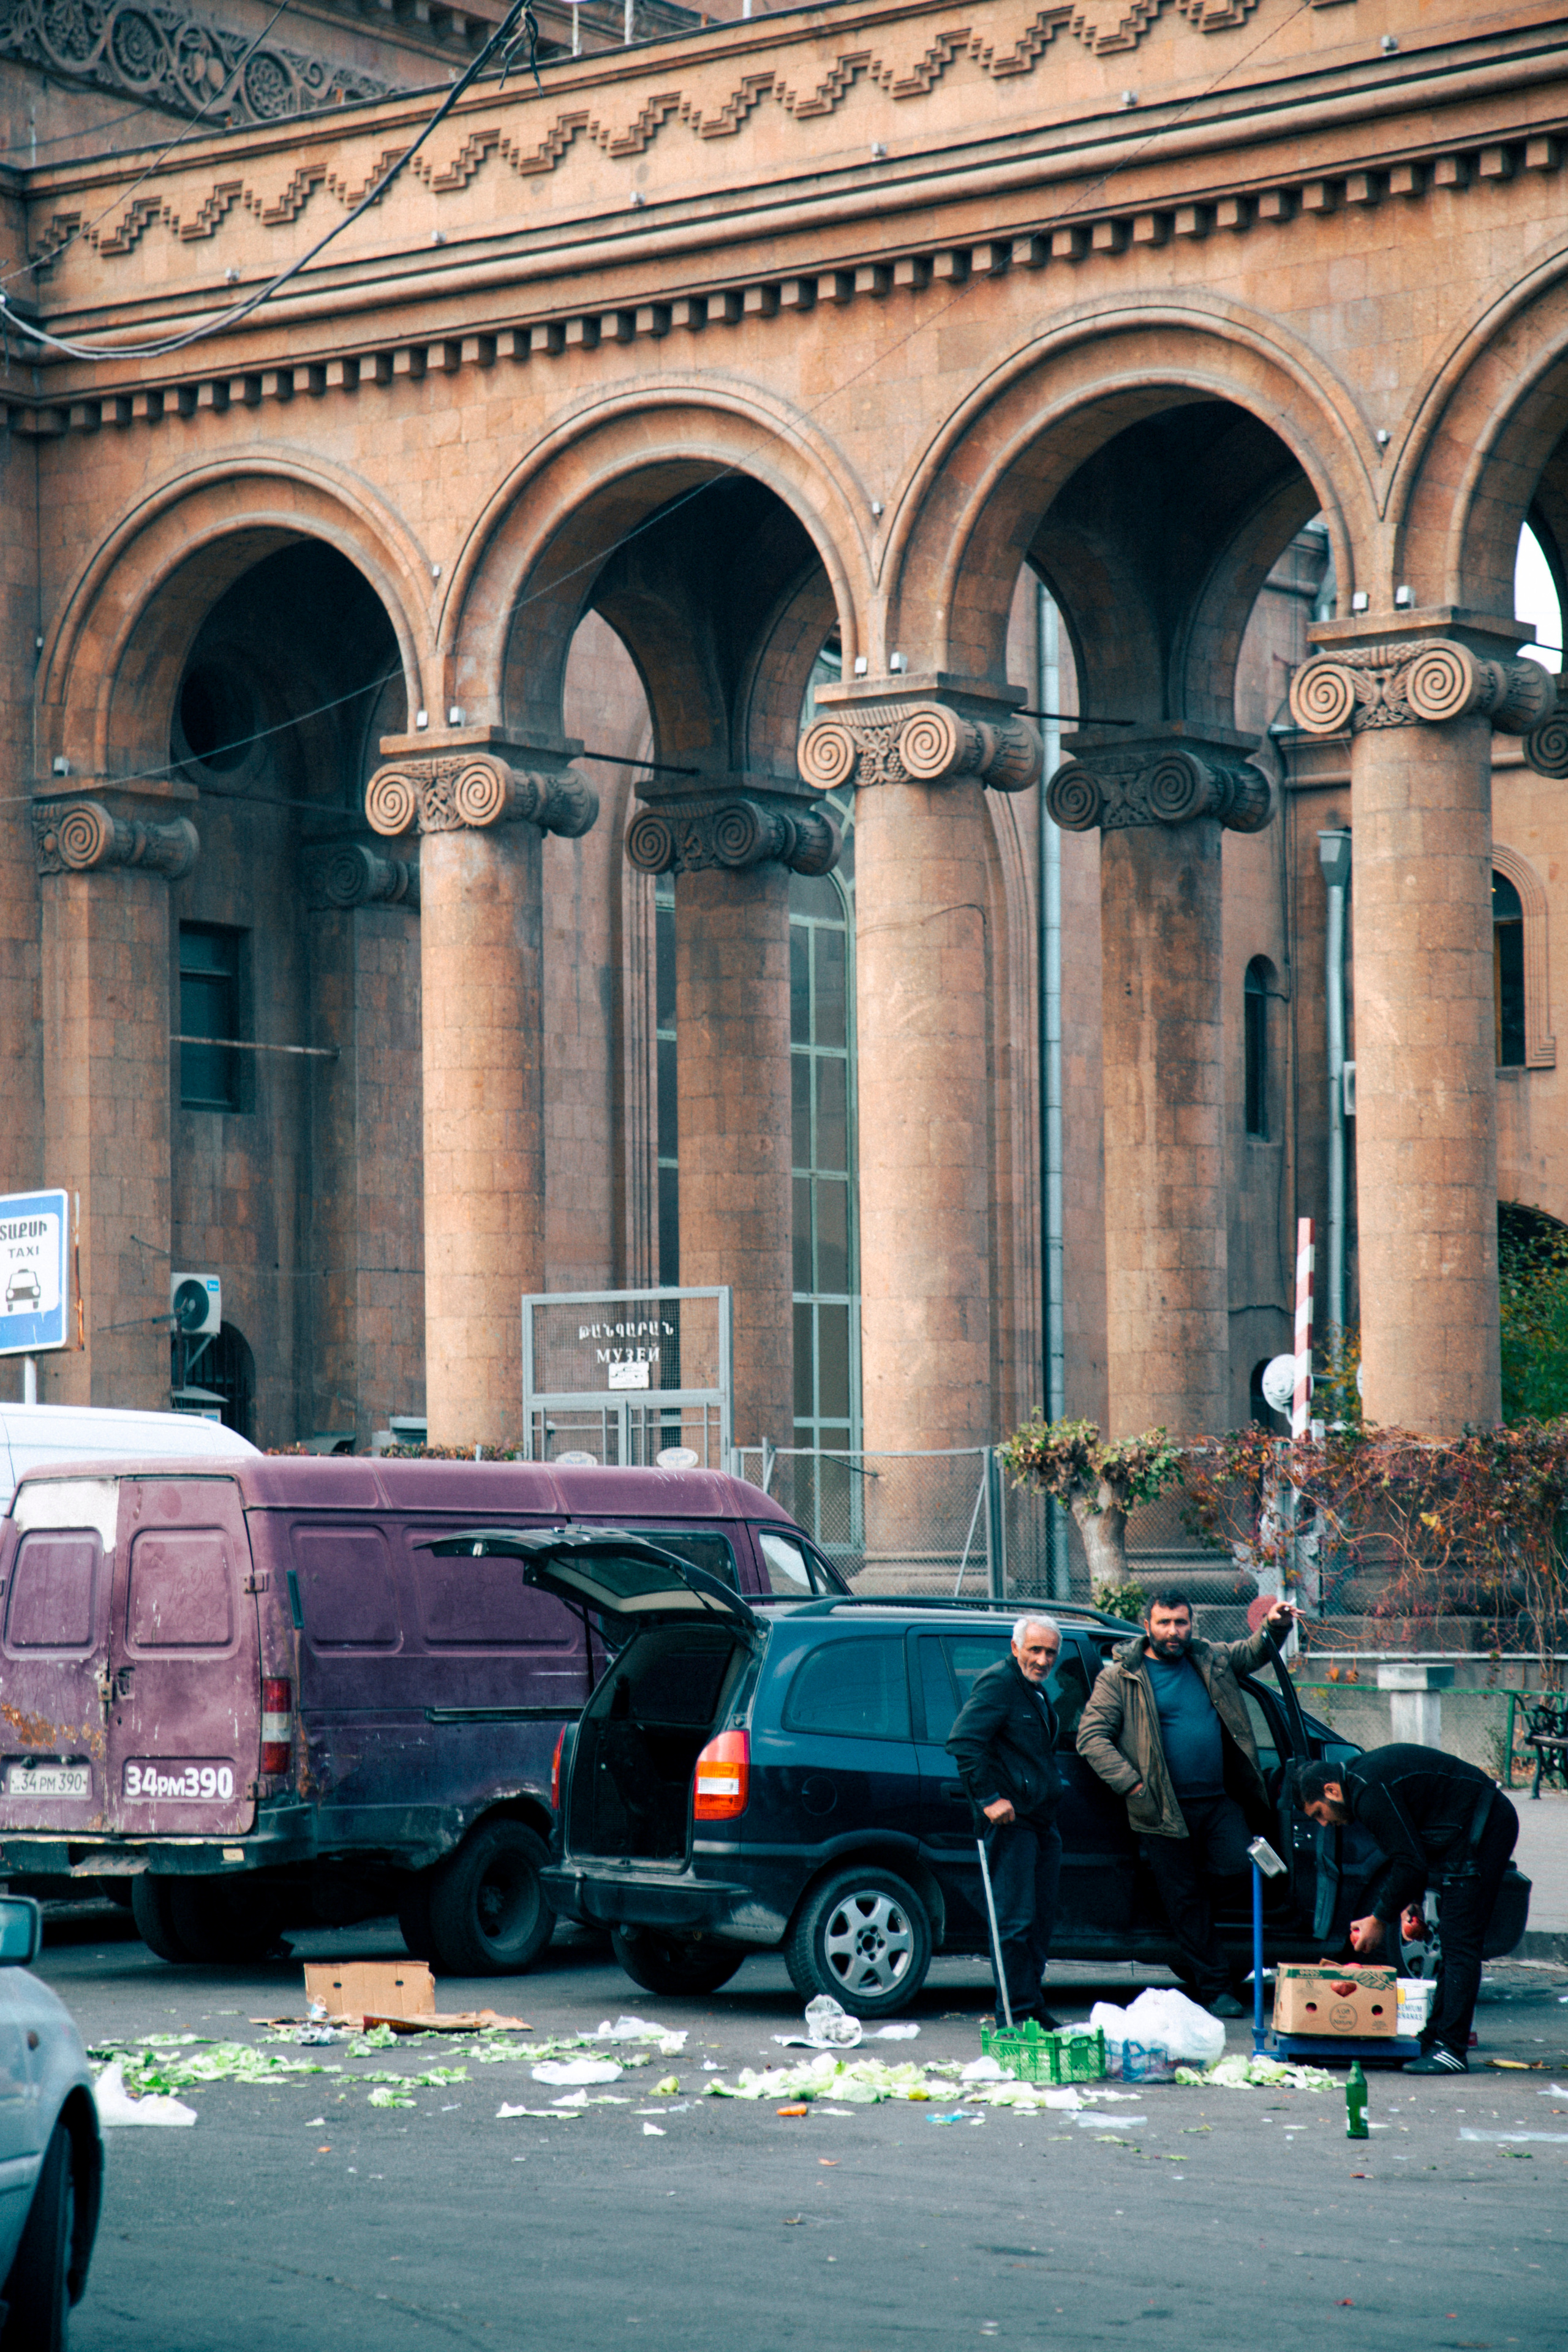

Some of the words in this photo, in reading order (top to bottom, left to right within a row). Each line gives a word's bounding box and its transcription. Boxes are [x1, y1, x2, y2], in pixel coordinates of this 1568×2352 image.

[7, 1245, 39, 1259] TAXI
[579, 1321, 674, 1340] ԹԱՆԳԱՐԱՆ
[596, 1342, 660, 1363] МУЗЕЙ
[21, 1773, 37, 1791] 34
[58, 1773, 83, 1791] 390
[1397, 2003, 1422, 2012] REMIUM
[1397, 2011, 1423, 2021] ANANAS
